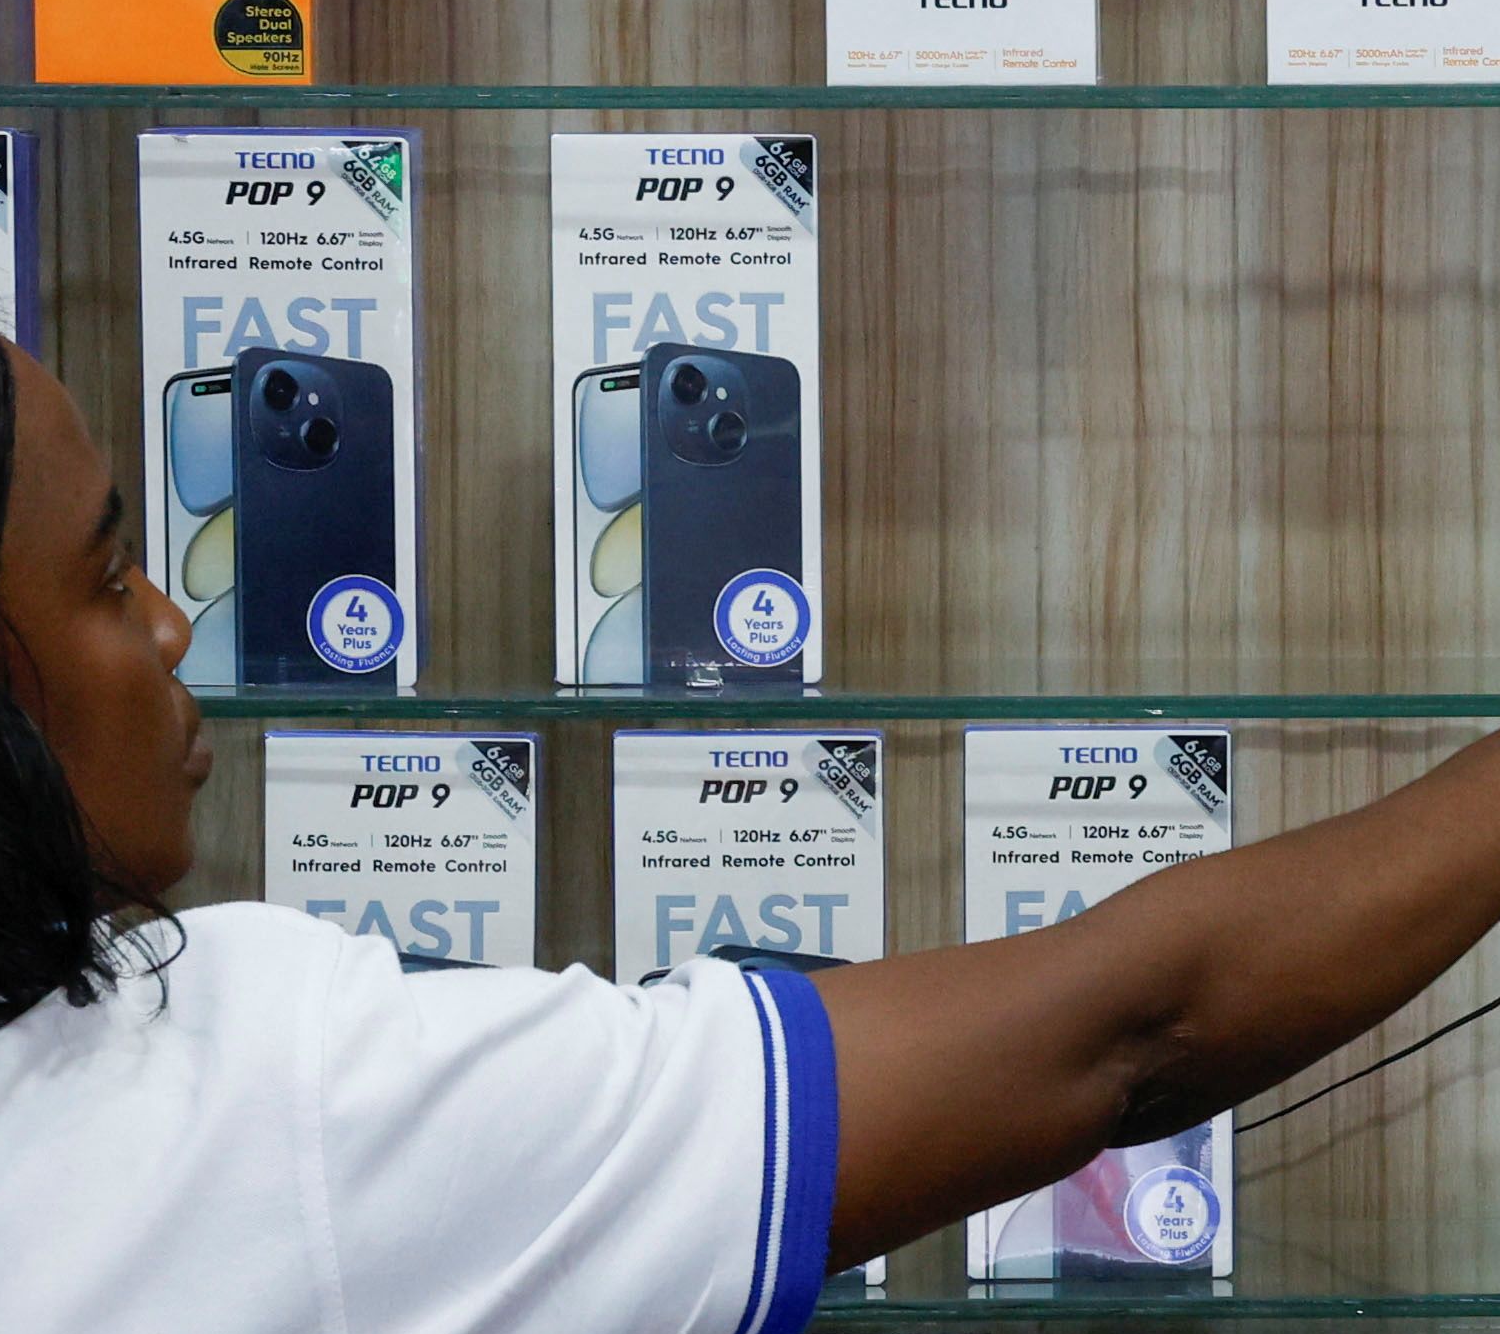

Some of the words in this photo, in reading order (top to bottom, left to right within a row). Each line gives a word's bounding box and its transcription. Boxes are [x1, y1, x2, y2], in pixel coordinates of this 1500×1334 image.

[236, 152, 316, 169] TECNO
[226, 181, 294, 205] POP
[306, 181, 326, 205] 9
[168, 231, 204, 245] 4.5G
[260, 232, 308, 245] 120Hz
[169, 257, 237, 269] Infrared
[250, 257, 312, 271] Remote
[322, 257, 384, 271] Control
[182, 297, 378, 367] FAST
[992, 851, 1060, 863] Infrared
